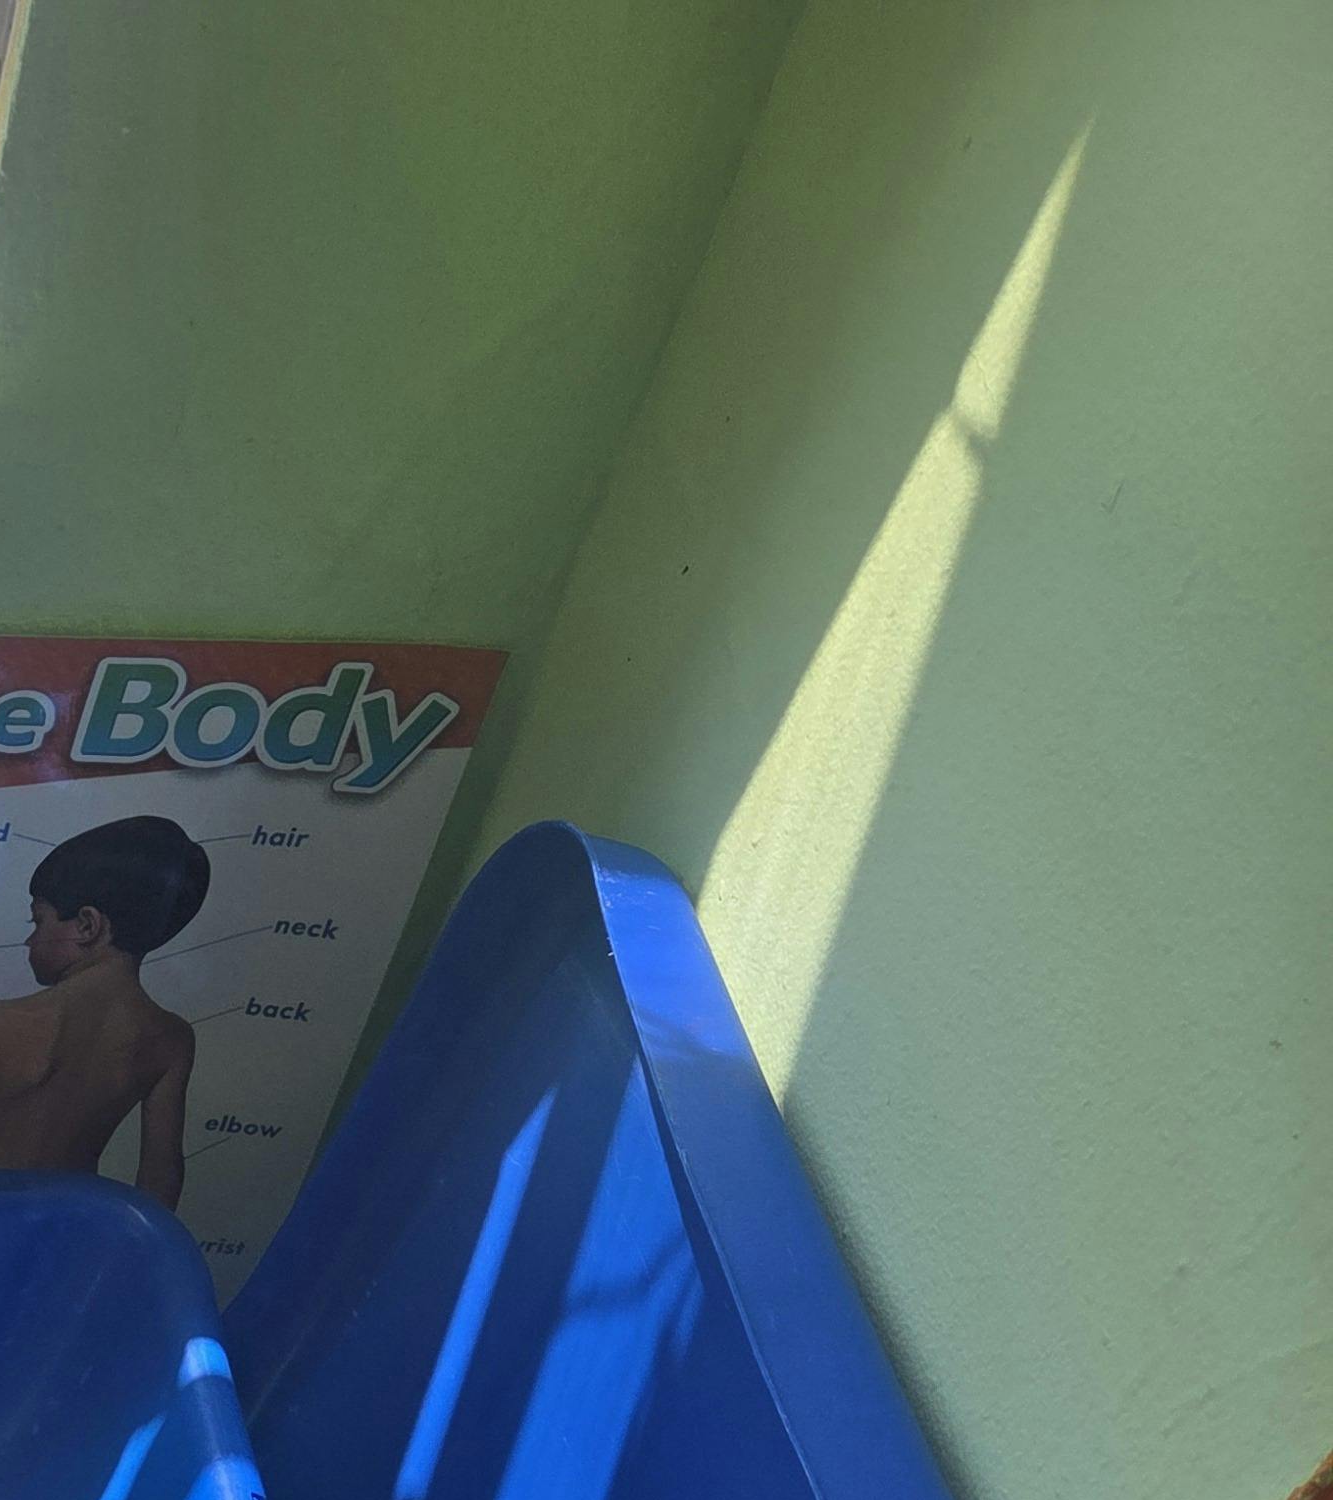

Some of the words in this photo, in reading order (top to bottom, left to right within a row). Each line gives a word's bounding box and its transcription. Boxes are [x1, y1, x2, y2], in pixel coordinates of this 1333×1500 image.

[71, 657, 459, 793] Body
[251, 826, 309, 850] hair
[273, 919, 338, 942] neck
[245, 998, 312, 1023] back
[205, 1115, 283, 1140] elbow
[200, 1238, 245, 1256] rist
